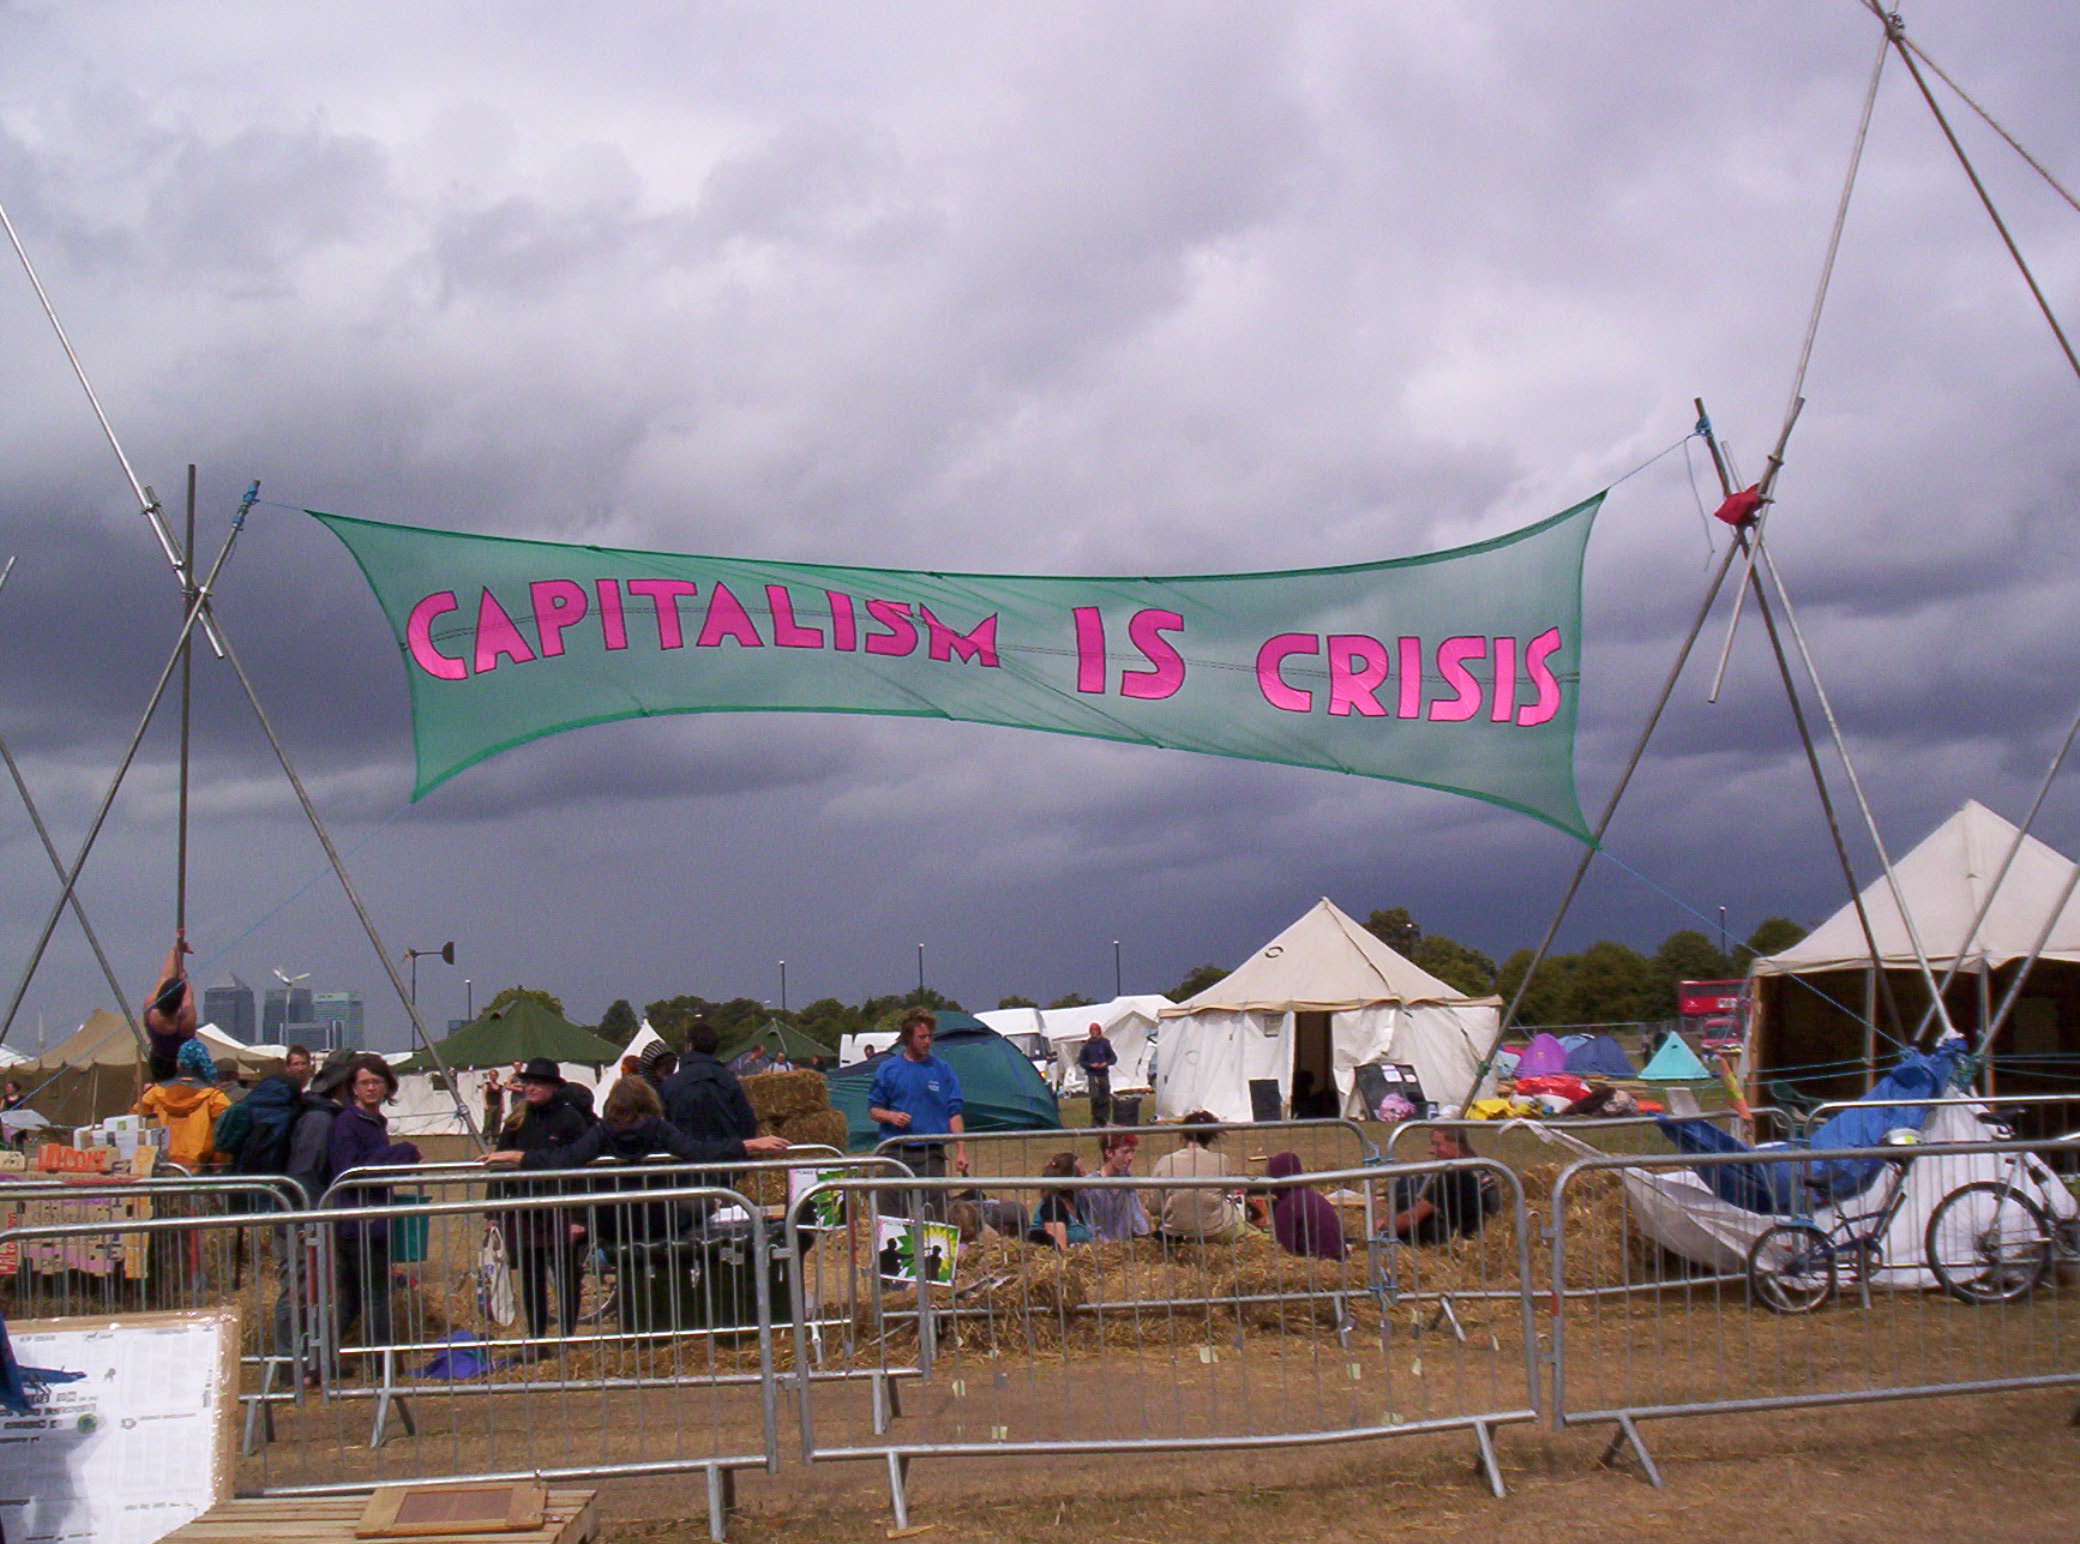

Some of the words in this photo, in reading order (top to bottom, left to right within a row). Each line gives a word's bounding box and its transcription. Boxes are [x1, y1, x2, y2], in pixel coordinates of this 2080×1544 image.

[405, 577, 1000, 681] CAPITALISM
[1071, 606, 1186, 700] IS
[1255, 626, 1562, 727] CRISIS
